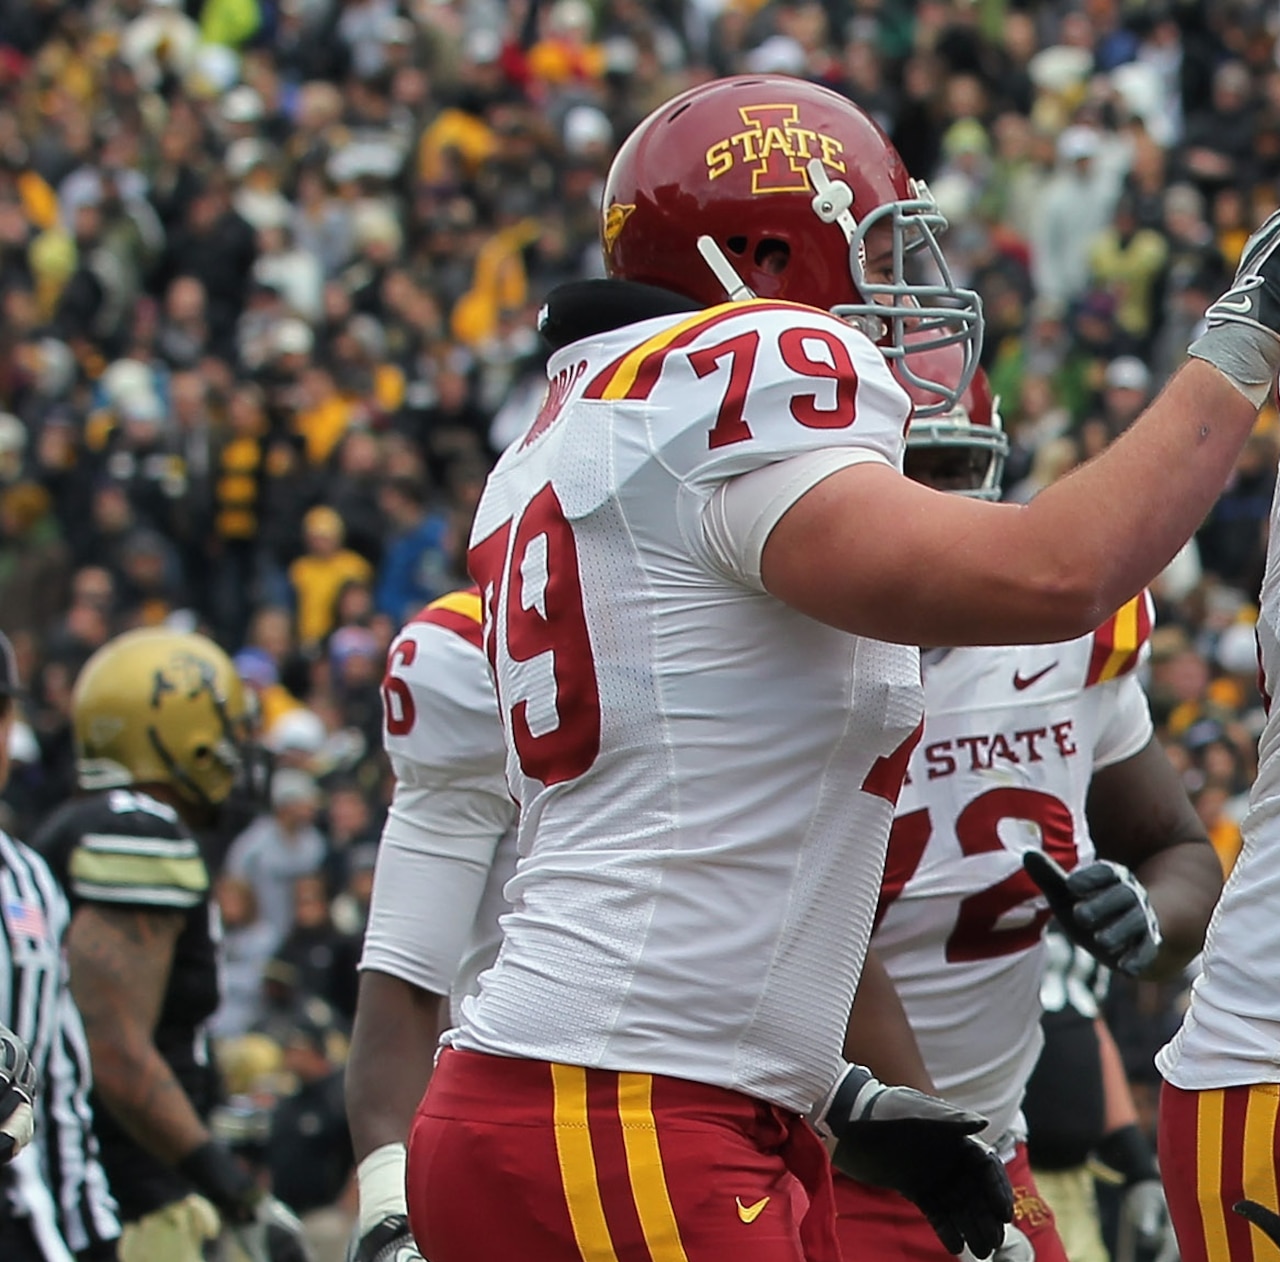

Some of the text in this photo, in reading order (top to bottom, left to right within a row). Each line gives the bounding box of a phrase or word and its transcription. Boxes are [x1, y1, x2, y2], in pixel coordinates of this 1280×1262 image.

[705, 127, 847, 180] STATE
[687, 327, 859, 451] 79
[467, 480, 601, 790] 79
[383, 638, 416, 737] 6
[925, 720, 1077, 780] STATE
